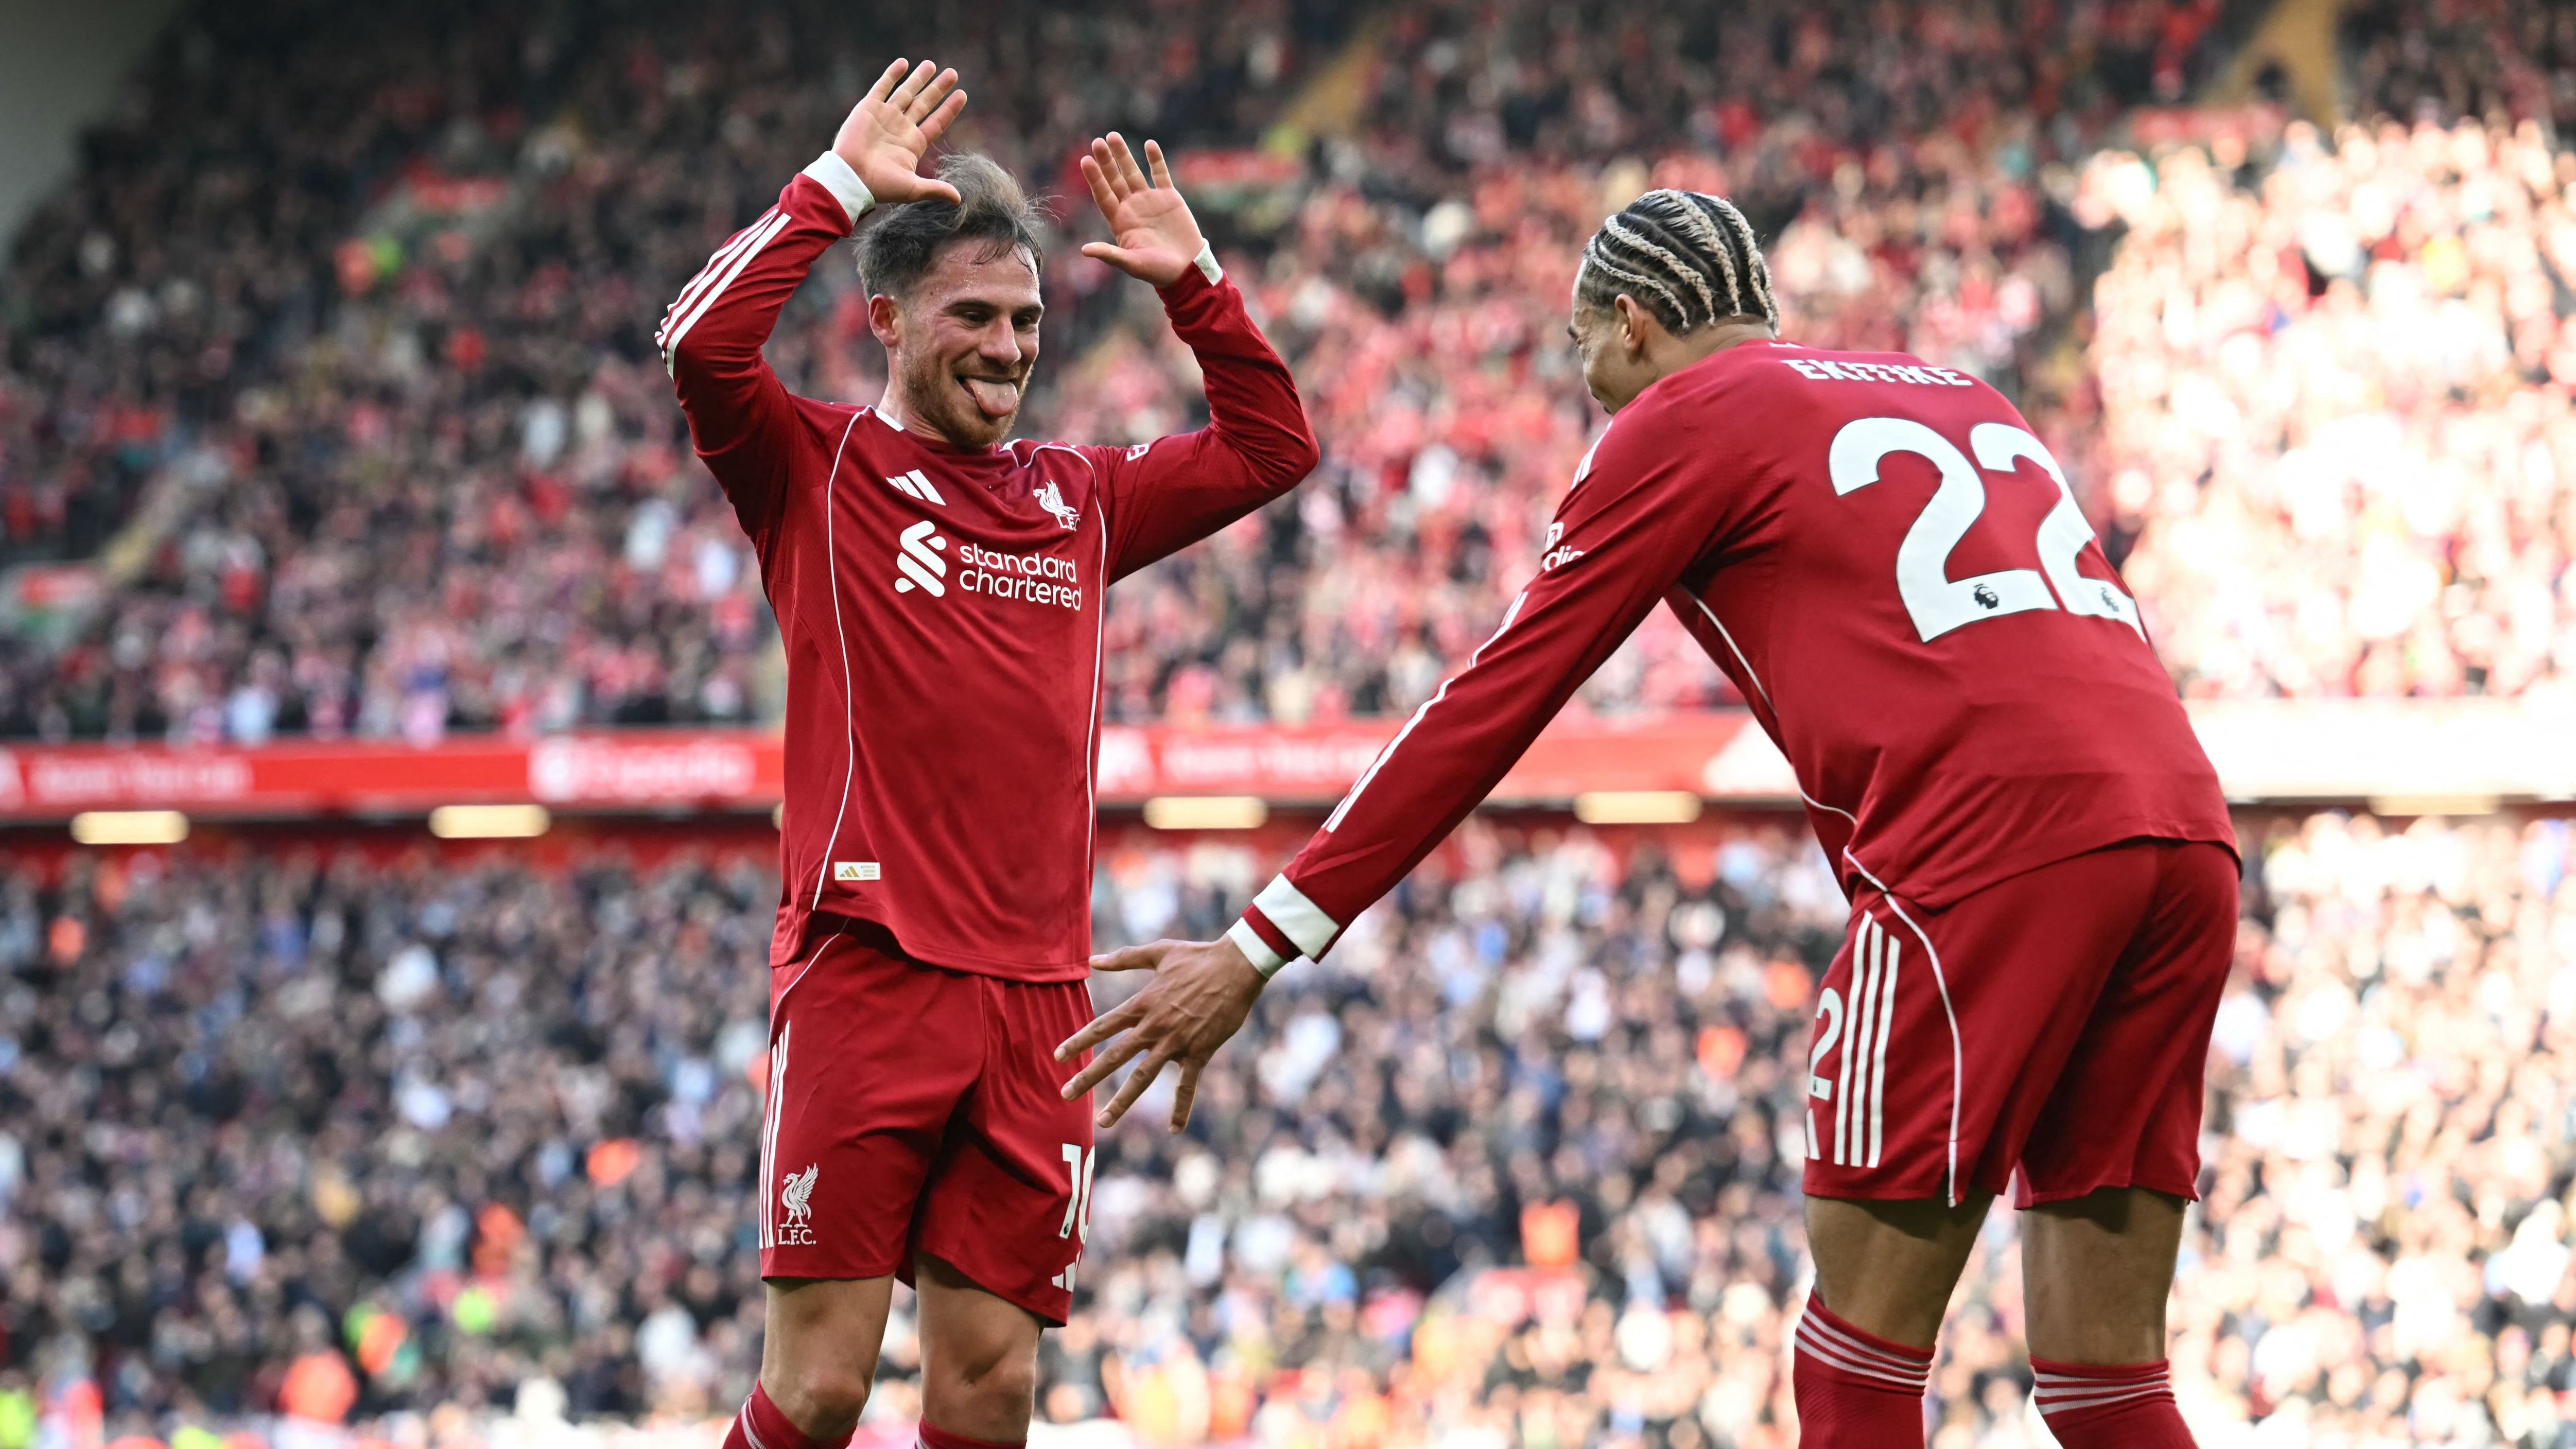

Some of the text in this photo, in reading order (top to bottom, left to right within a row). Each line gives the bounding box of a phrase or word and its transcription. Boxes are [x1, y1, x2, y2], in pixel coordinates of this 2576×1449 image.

[1781, 359, 1974, 386] EKITIKE
[1829, 416, 2149, 644] 22
[959, 543, 1077, 583] standard
[959, 566, 1082, 612] chartered
[777, 1229, 817, 1245] L.F.C.
